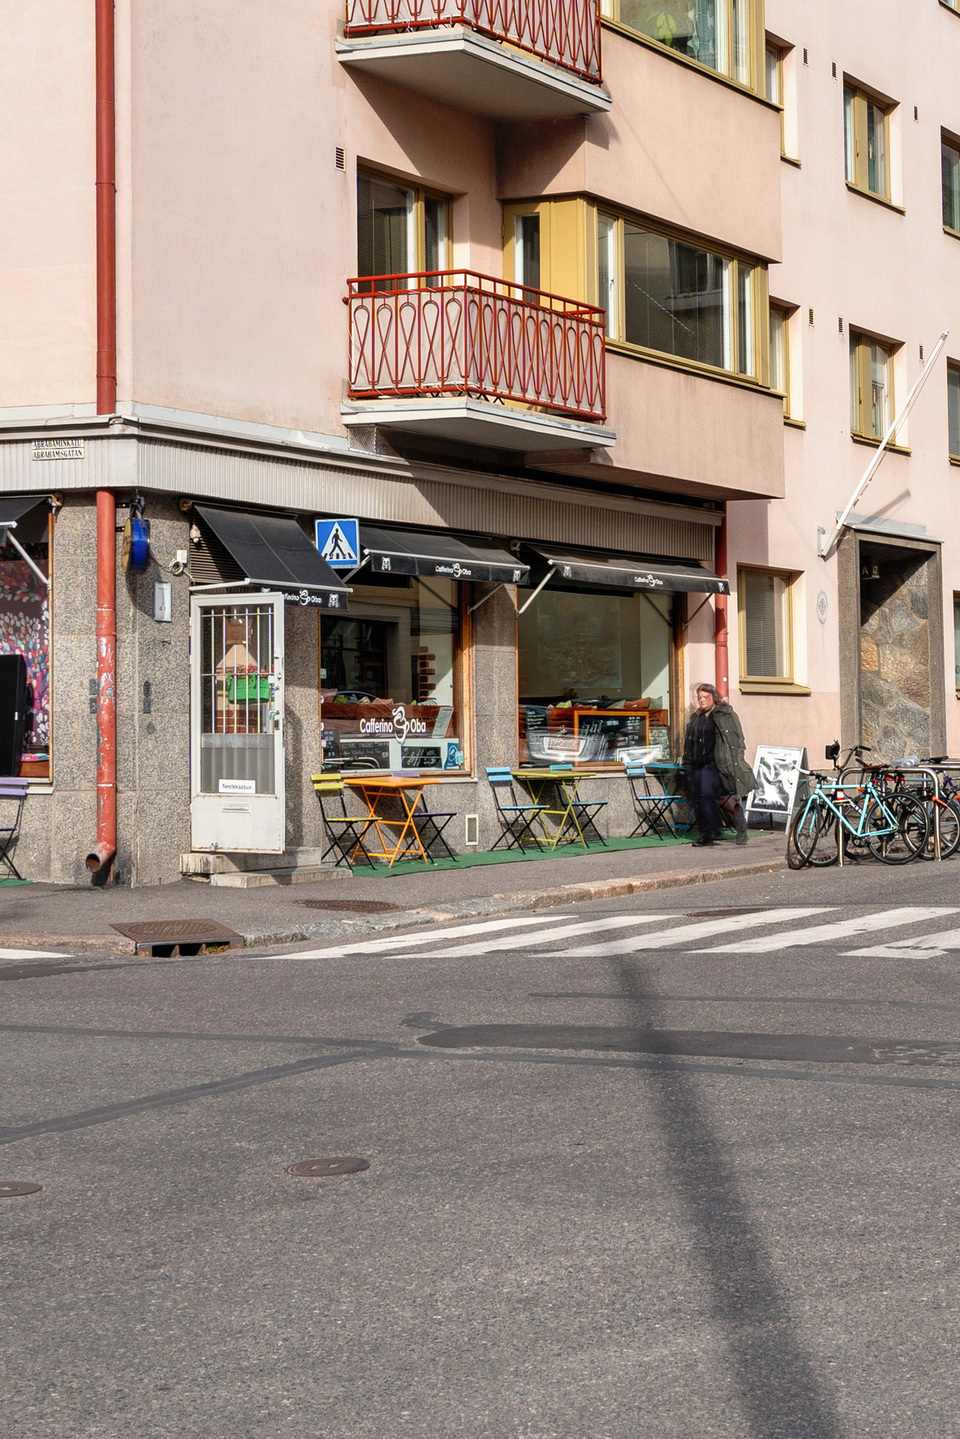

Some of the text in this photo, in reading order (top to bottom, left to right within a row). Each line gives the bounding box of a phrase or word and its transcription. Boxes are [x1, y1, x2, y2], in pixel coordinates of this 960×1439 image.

[34, 450, 83, 458] ABRAHAMSGATAN
[462, 568, 472, 576] Oba
[311, 595, 322, 603] Oba
[360, 718, 393, 733] Cafferino
[410, 719, 426, 732] Oba
